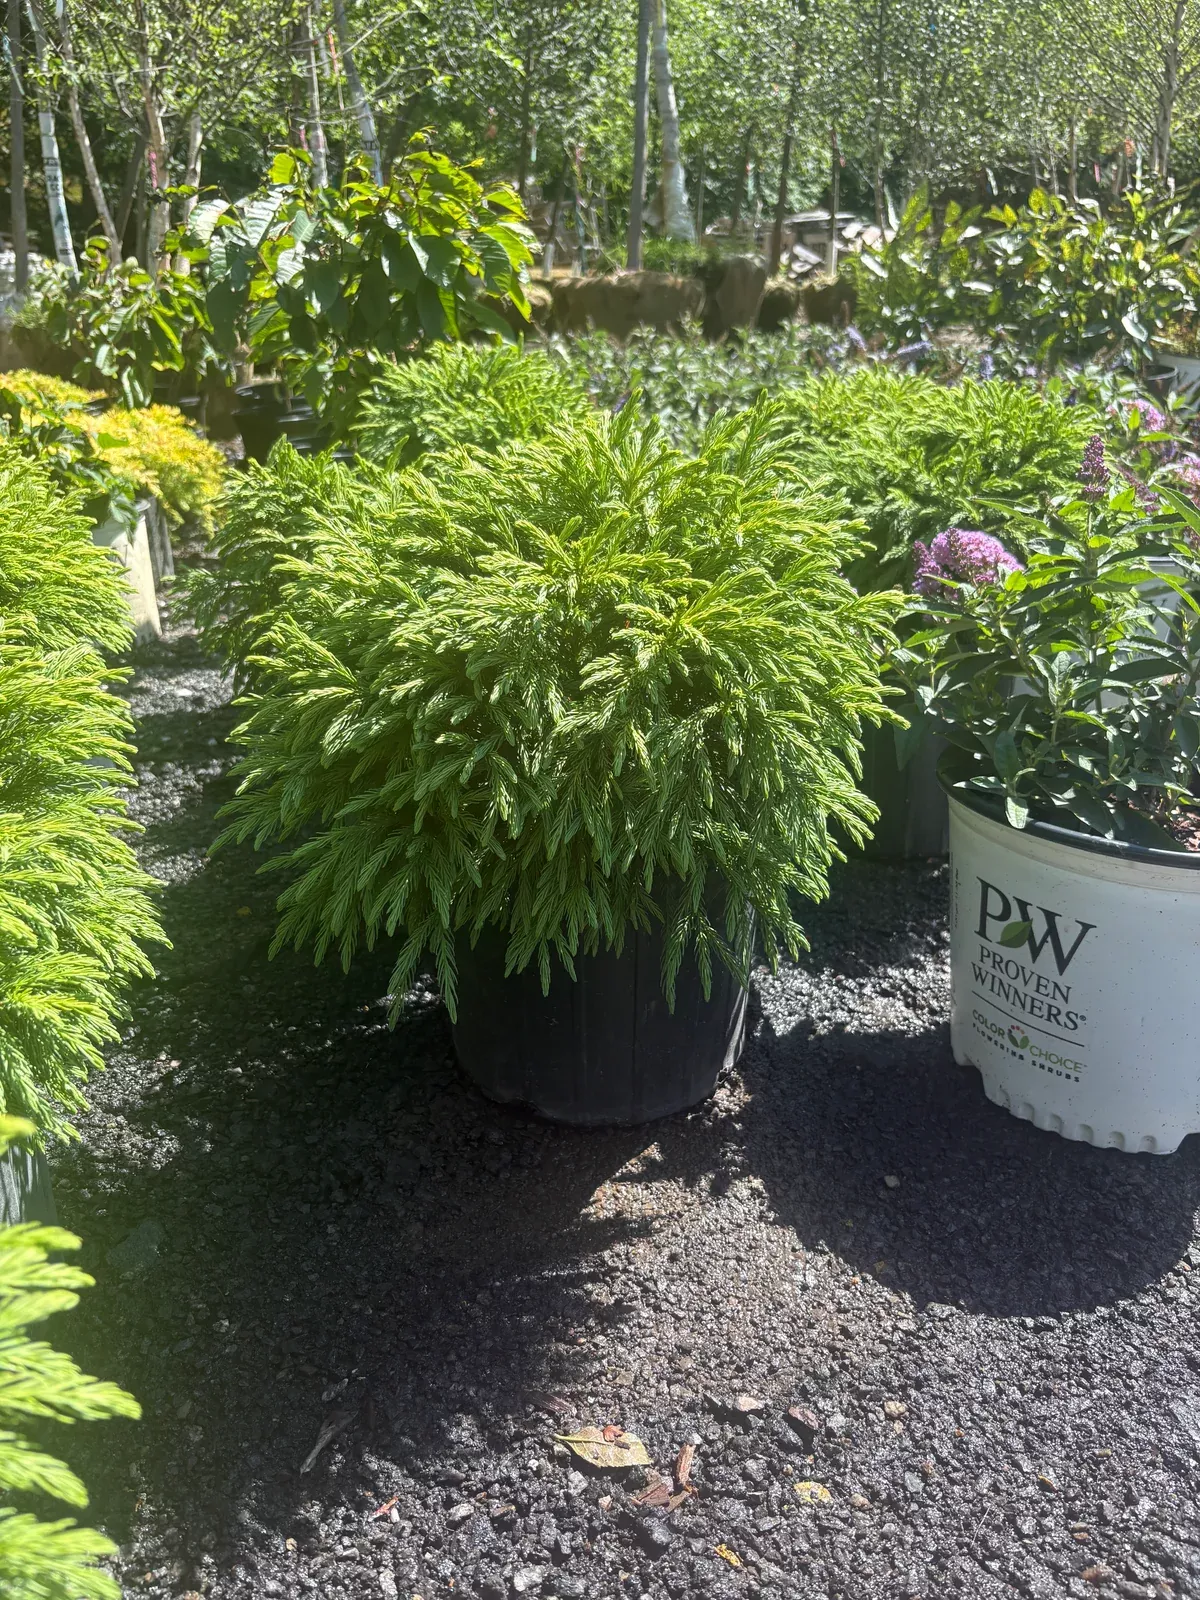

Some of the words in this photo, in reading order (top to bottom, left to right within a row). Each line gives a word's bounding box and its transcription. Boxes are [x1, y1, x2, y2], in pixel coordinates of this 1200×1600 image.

[974, 876, 1097, 976] PW
[979, 944, 1072, 1004] PROVEN
[972, 1009, 1006, 1039] COLOR
[972, 1022, 1025, 1061] FLOWERING
[1031, 1060, 1080, 1083] SHRUBS
